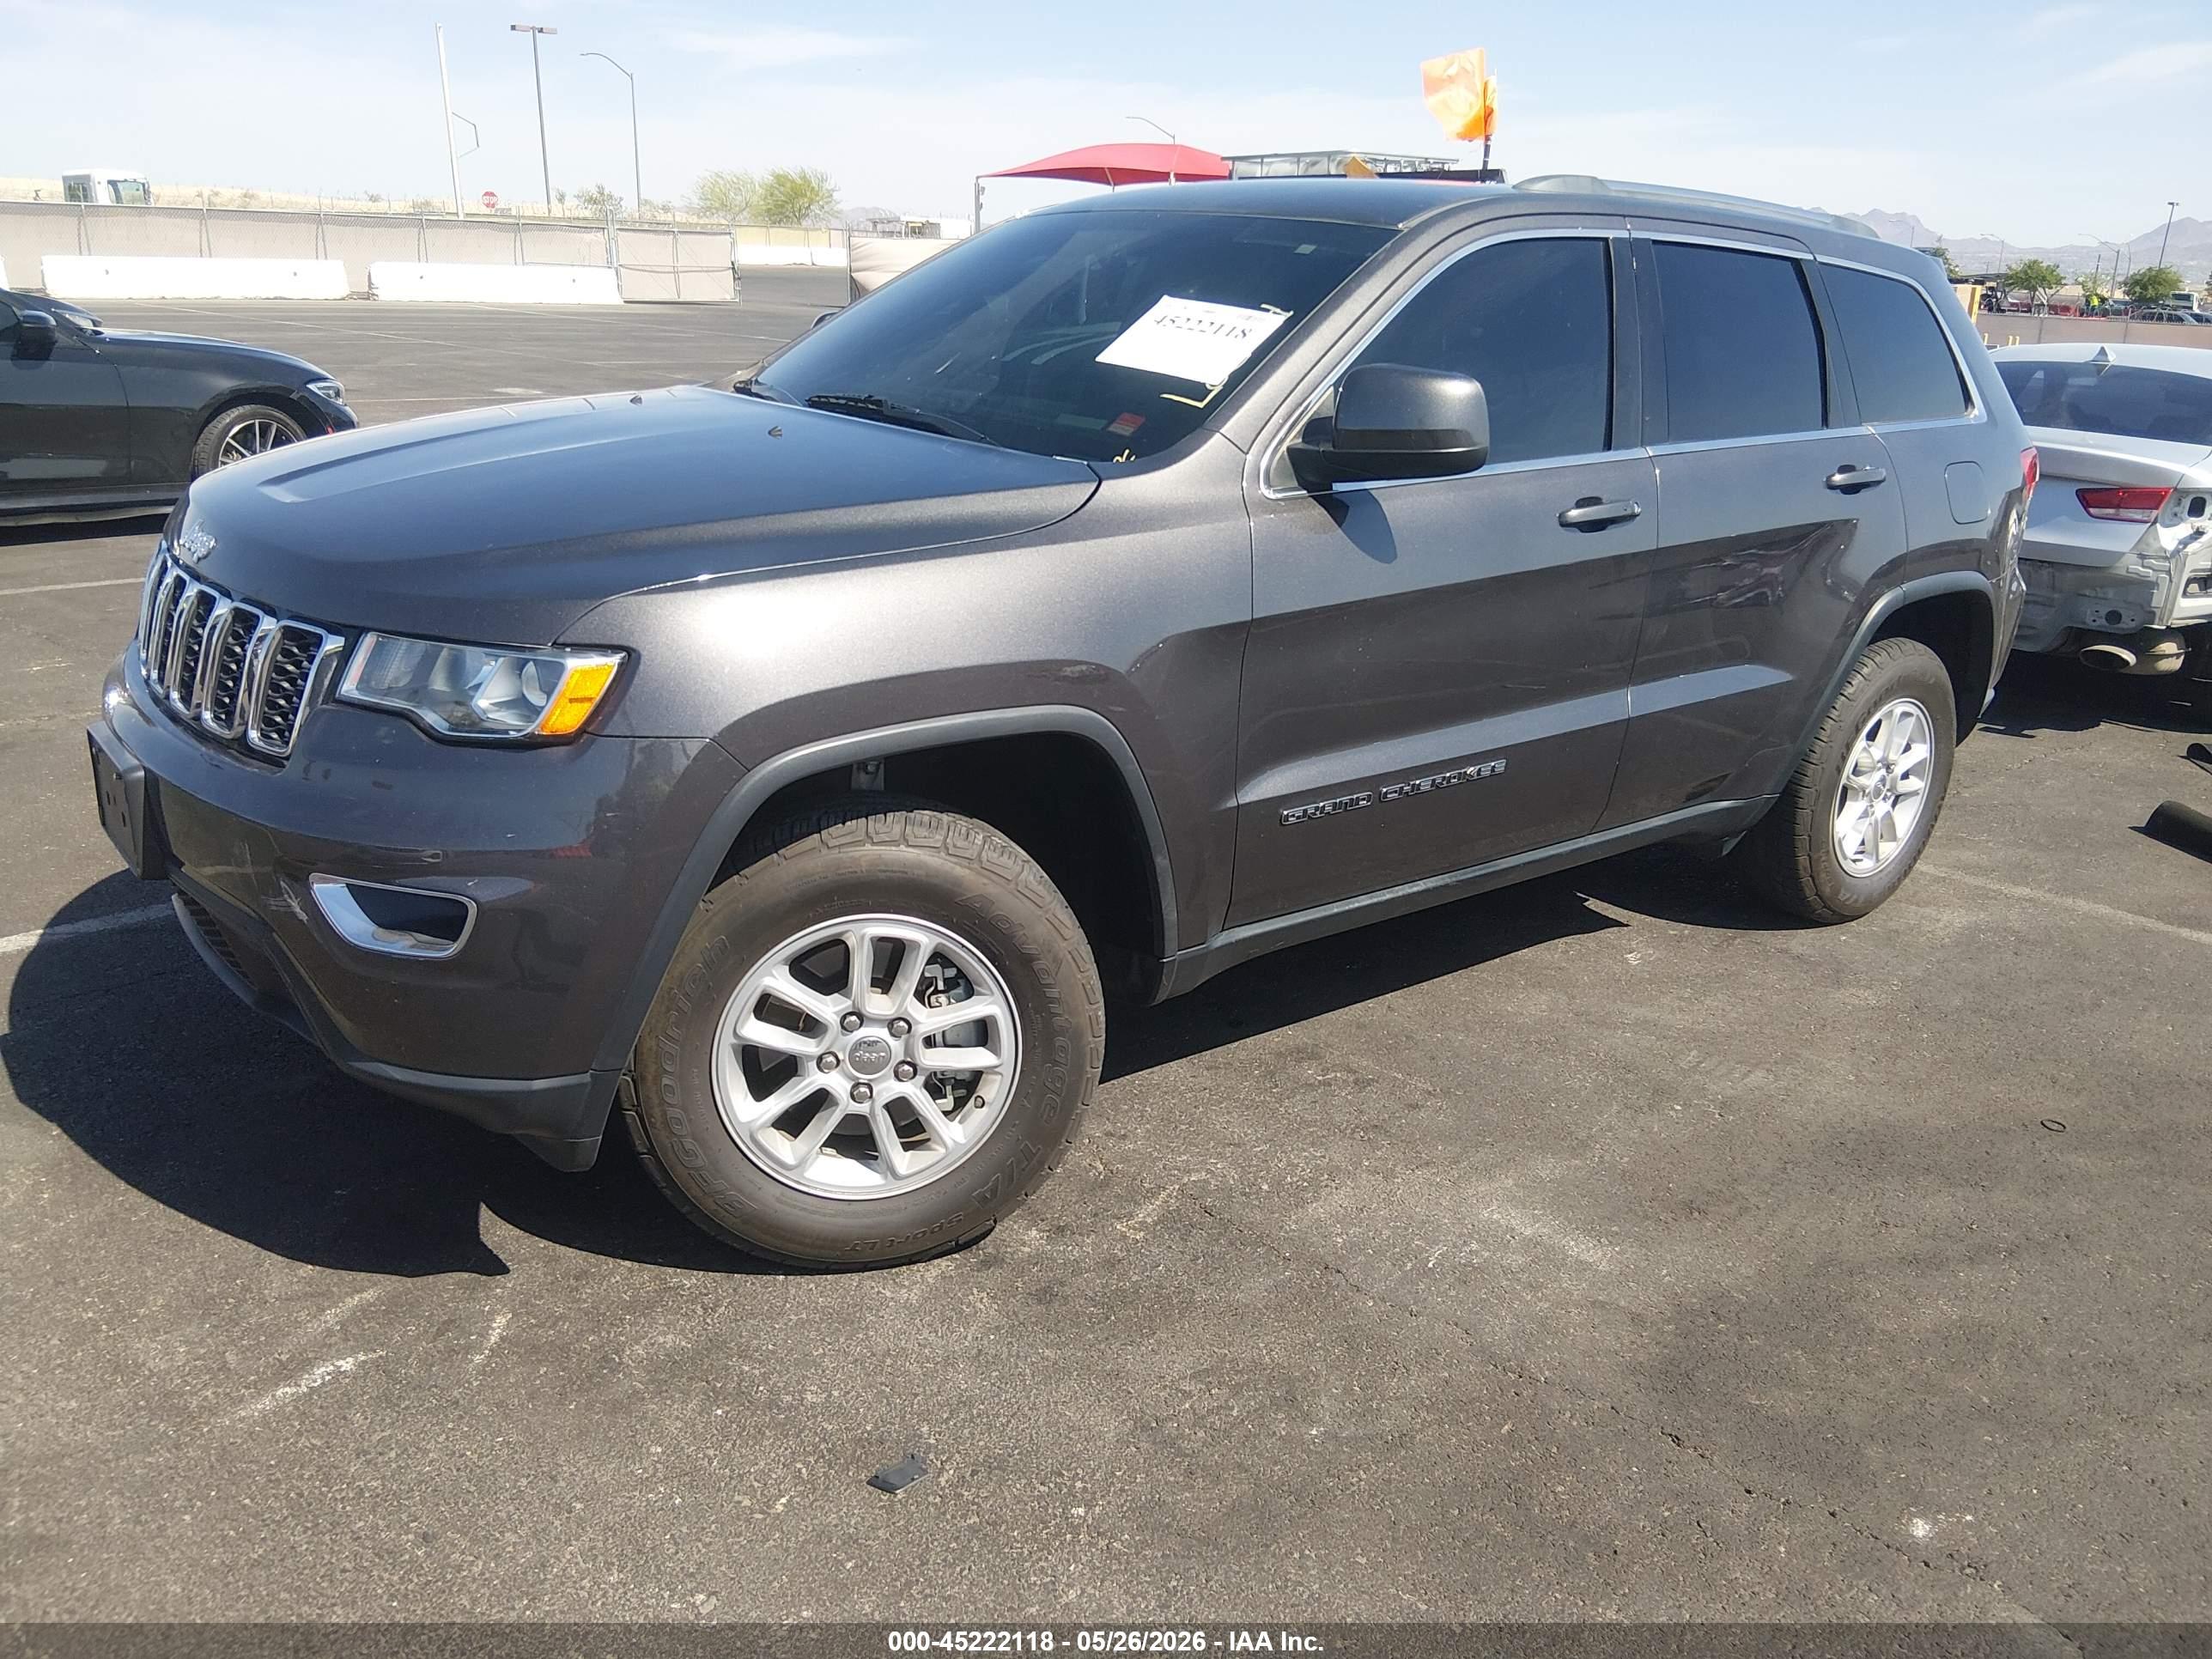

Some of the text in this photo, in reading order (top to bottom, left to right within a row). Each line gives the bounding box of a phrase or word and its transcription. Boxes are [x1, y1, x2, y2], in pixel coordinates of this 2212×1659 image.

[1280, 759, 1507, 824] GRAND CHEROKEE
[659, 935, 758, 1218] BFGoodrich
